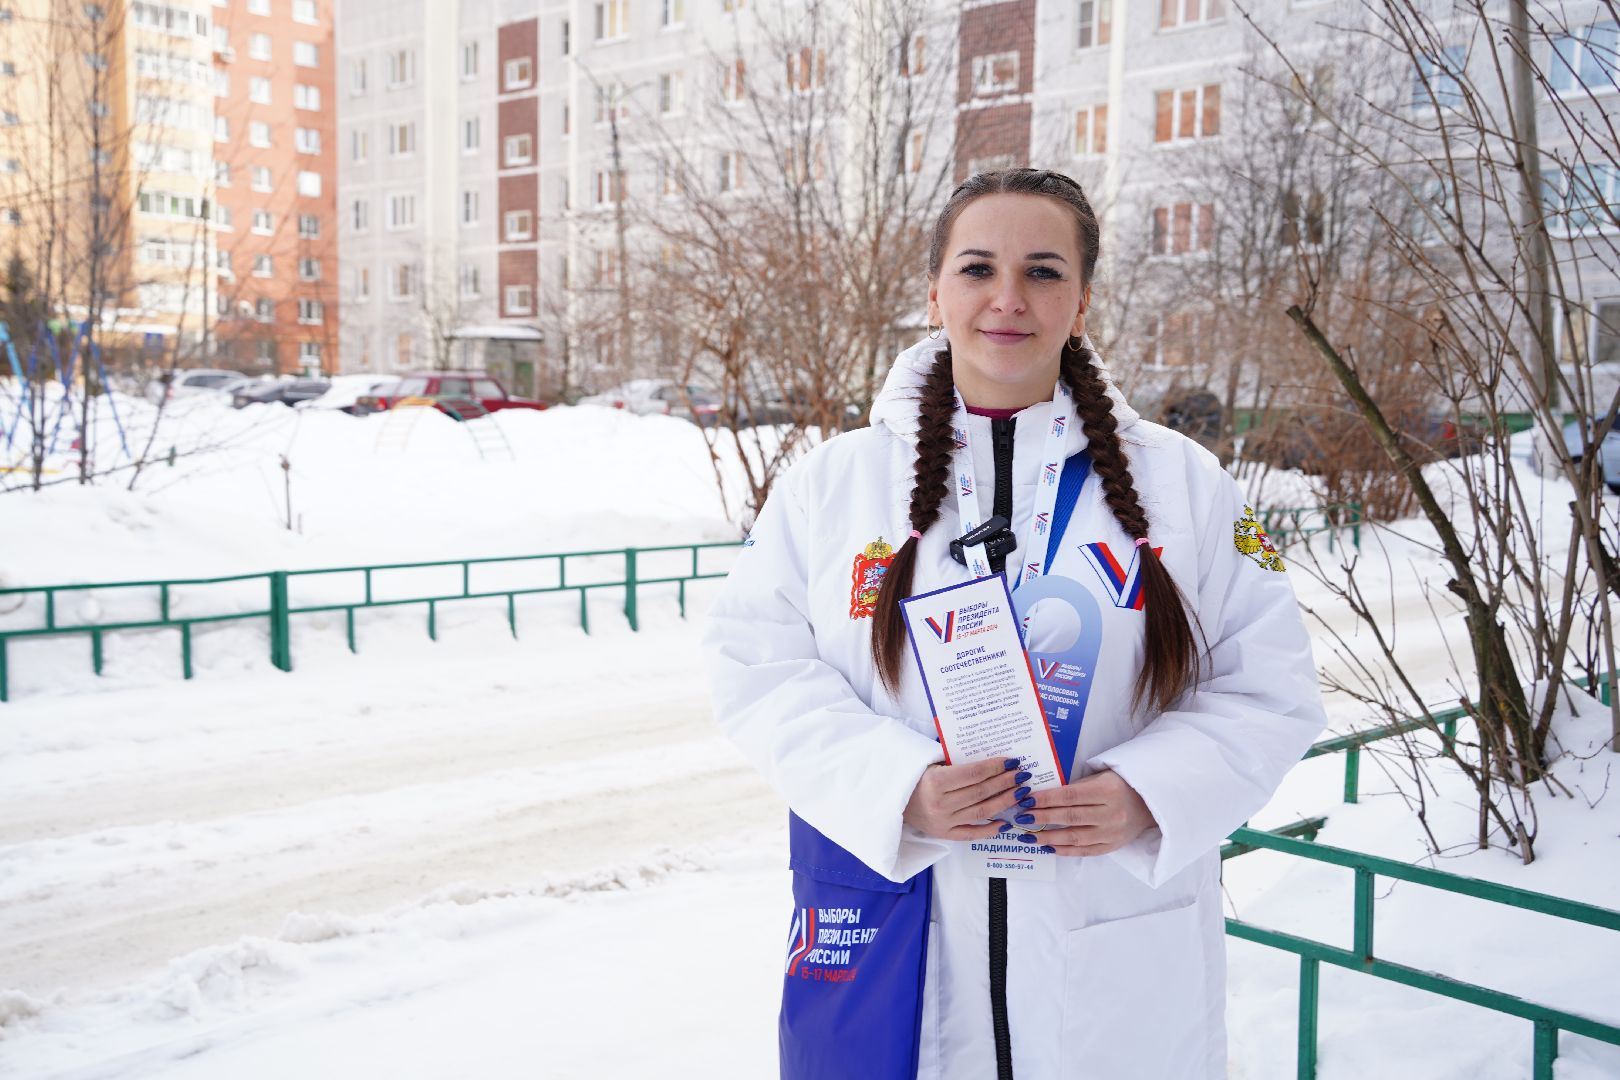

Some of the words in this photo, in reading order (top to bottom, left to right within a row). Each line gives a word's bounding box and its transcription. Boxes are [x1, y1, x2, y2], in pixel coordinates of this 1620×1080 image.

[958, 606, 1000, 624] ПРЕЗИДЕНТА
[959, 601, 988, 615] ВЫБОРЫ
[957, 620, 984, 633] РОССИИ
[940, 649, 1007, 674] СООТЕЧЕСТВЕННИКИ!
[956, 646, 986, 661] ДОРОГИЕ
[818, 908, 861, 924] ВЫБОРЫ
[803, 948, 850, 965] РОССИИ
